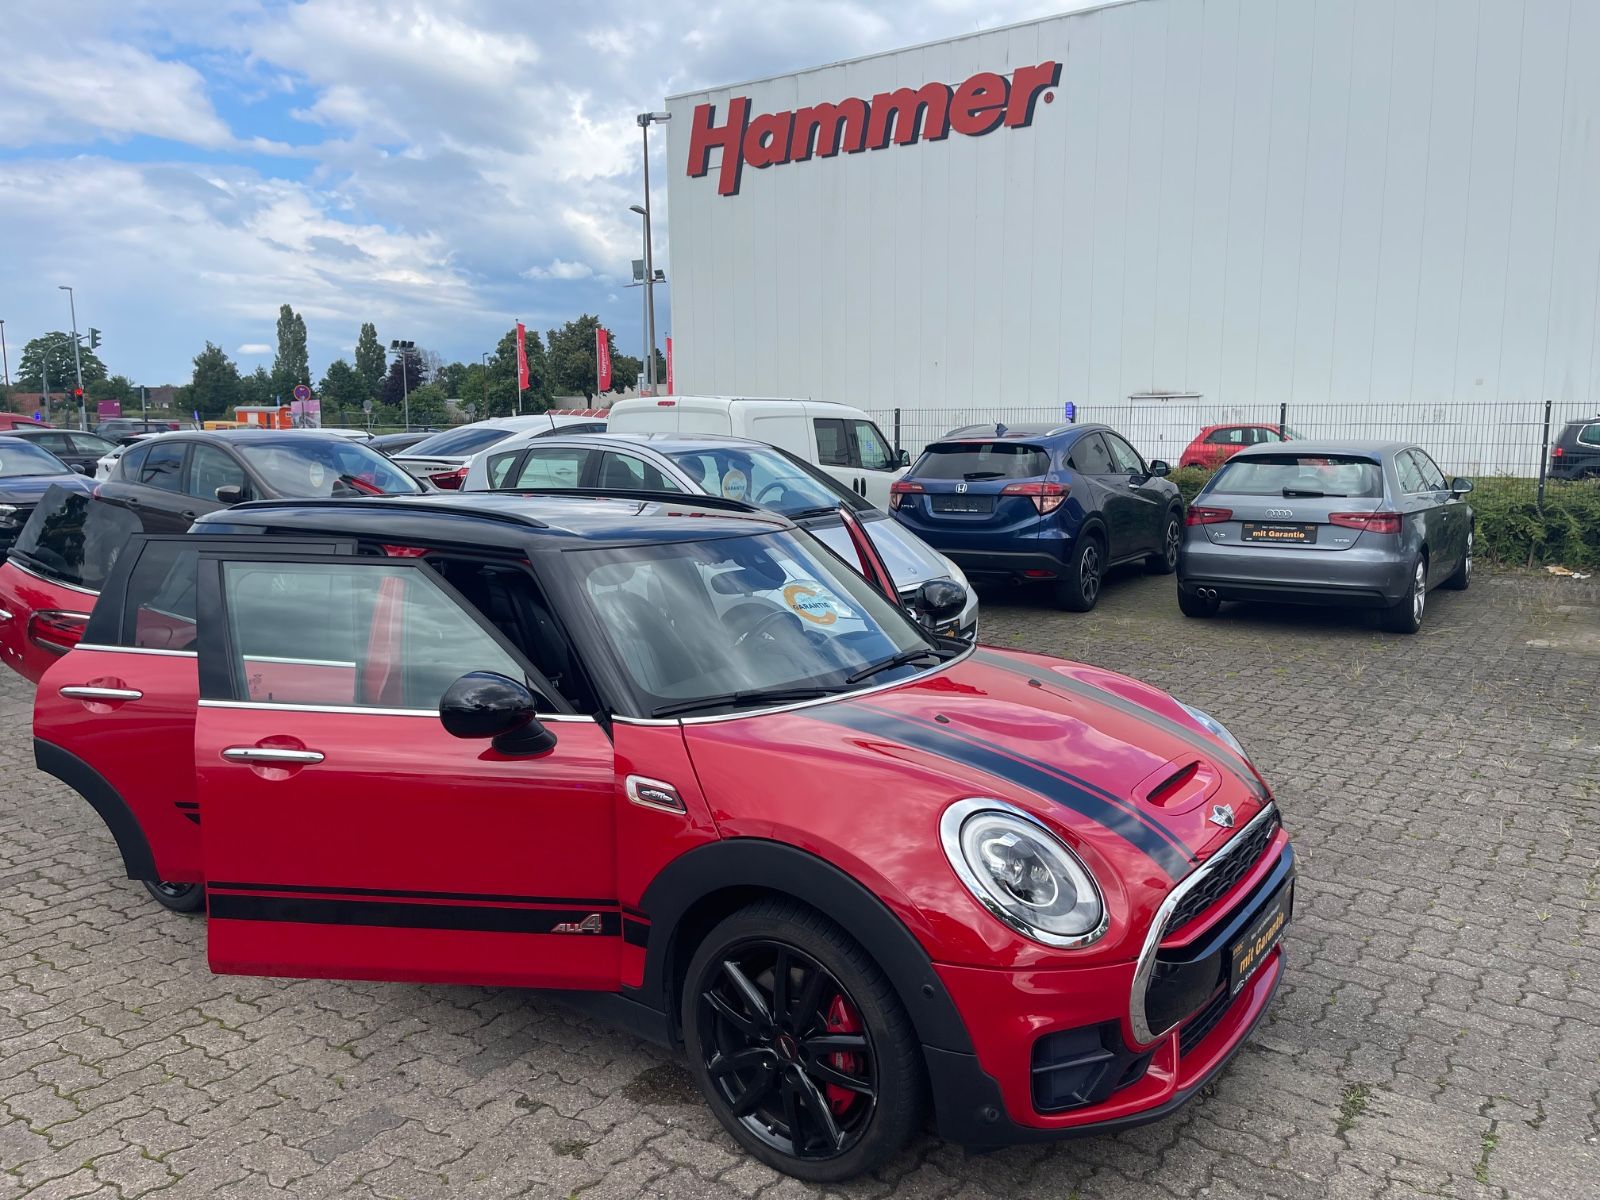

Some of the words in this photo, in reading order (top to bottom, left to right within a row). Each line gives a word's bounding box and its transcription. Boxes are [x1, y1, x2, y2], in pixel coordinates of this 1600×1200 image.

[687, 61, 1063, 196] Hammer
[1268, 530, 1305, 539] Garantie
[1239, 946, 1254, 974] mit
[1255, 911, 1285, 956] Garantie
